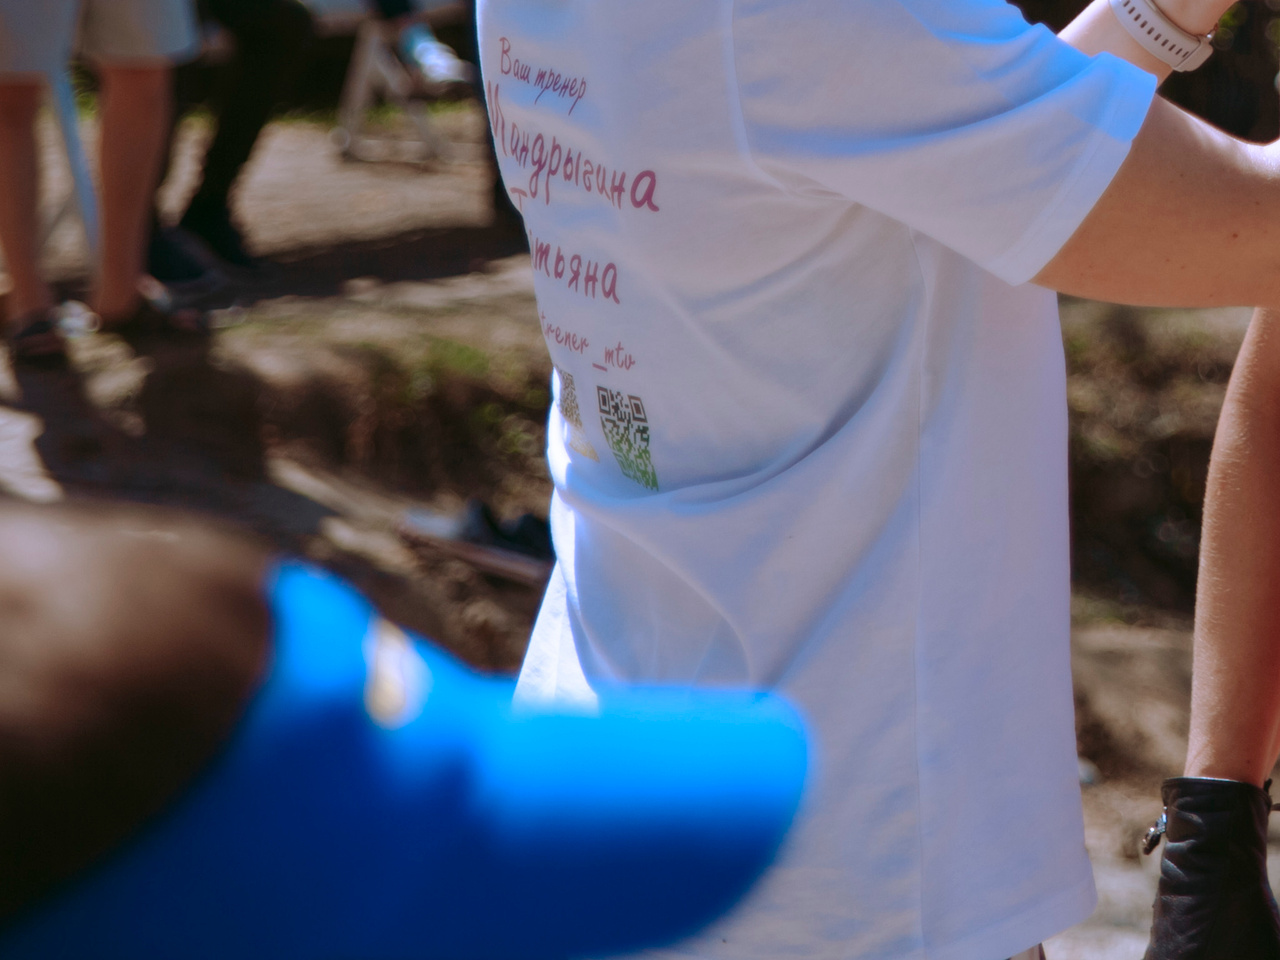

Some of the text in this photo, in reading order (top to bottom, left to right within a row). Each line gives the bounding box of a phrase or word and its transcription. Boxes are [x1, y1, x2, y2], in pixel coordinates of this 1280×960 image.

[499, 37, 587, 116] Ваш тренер
[487, 80, 660, 212] Мандрыгина
[510, 187, 620, 305] Ттьяна
